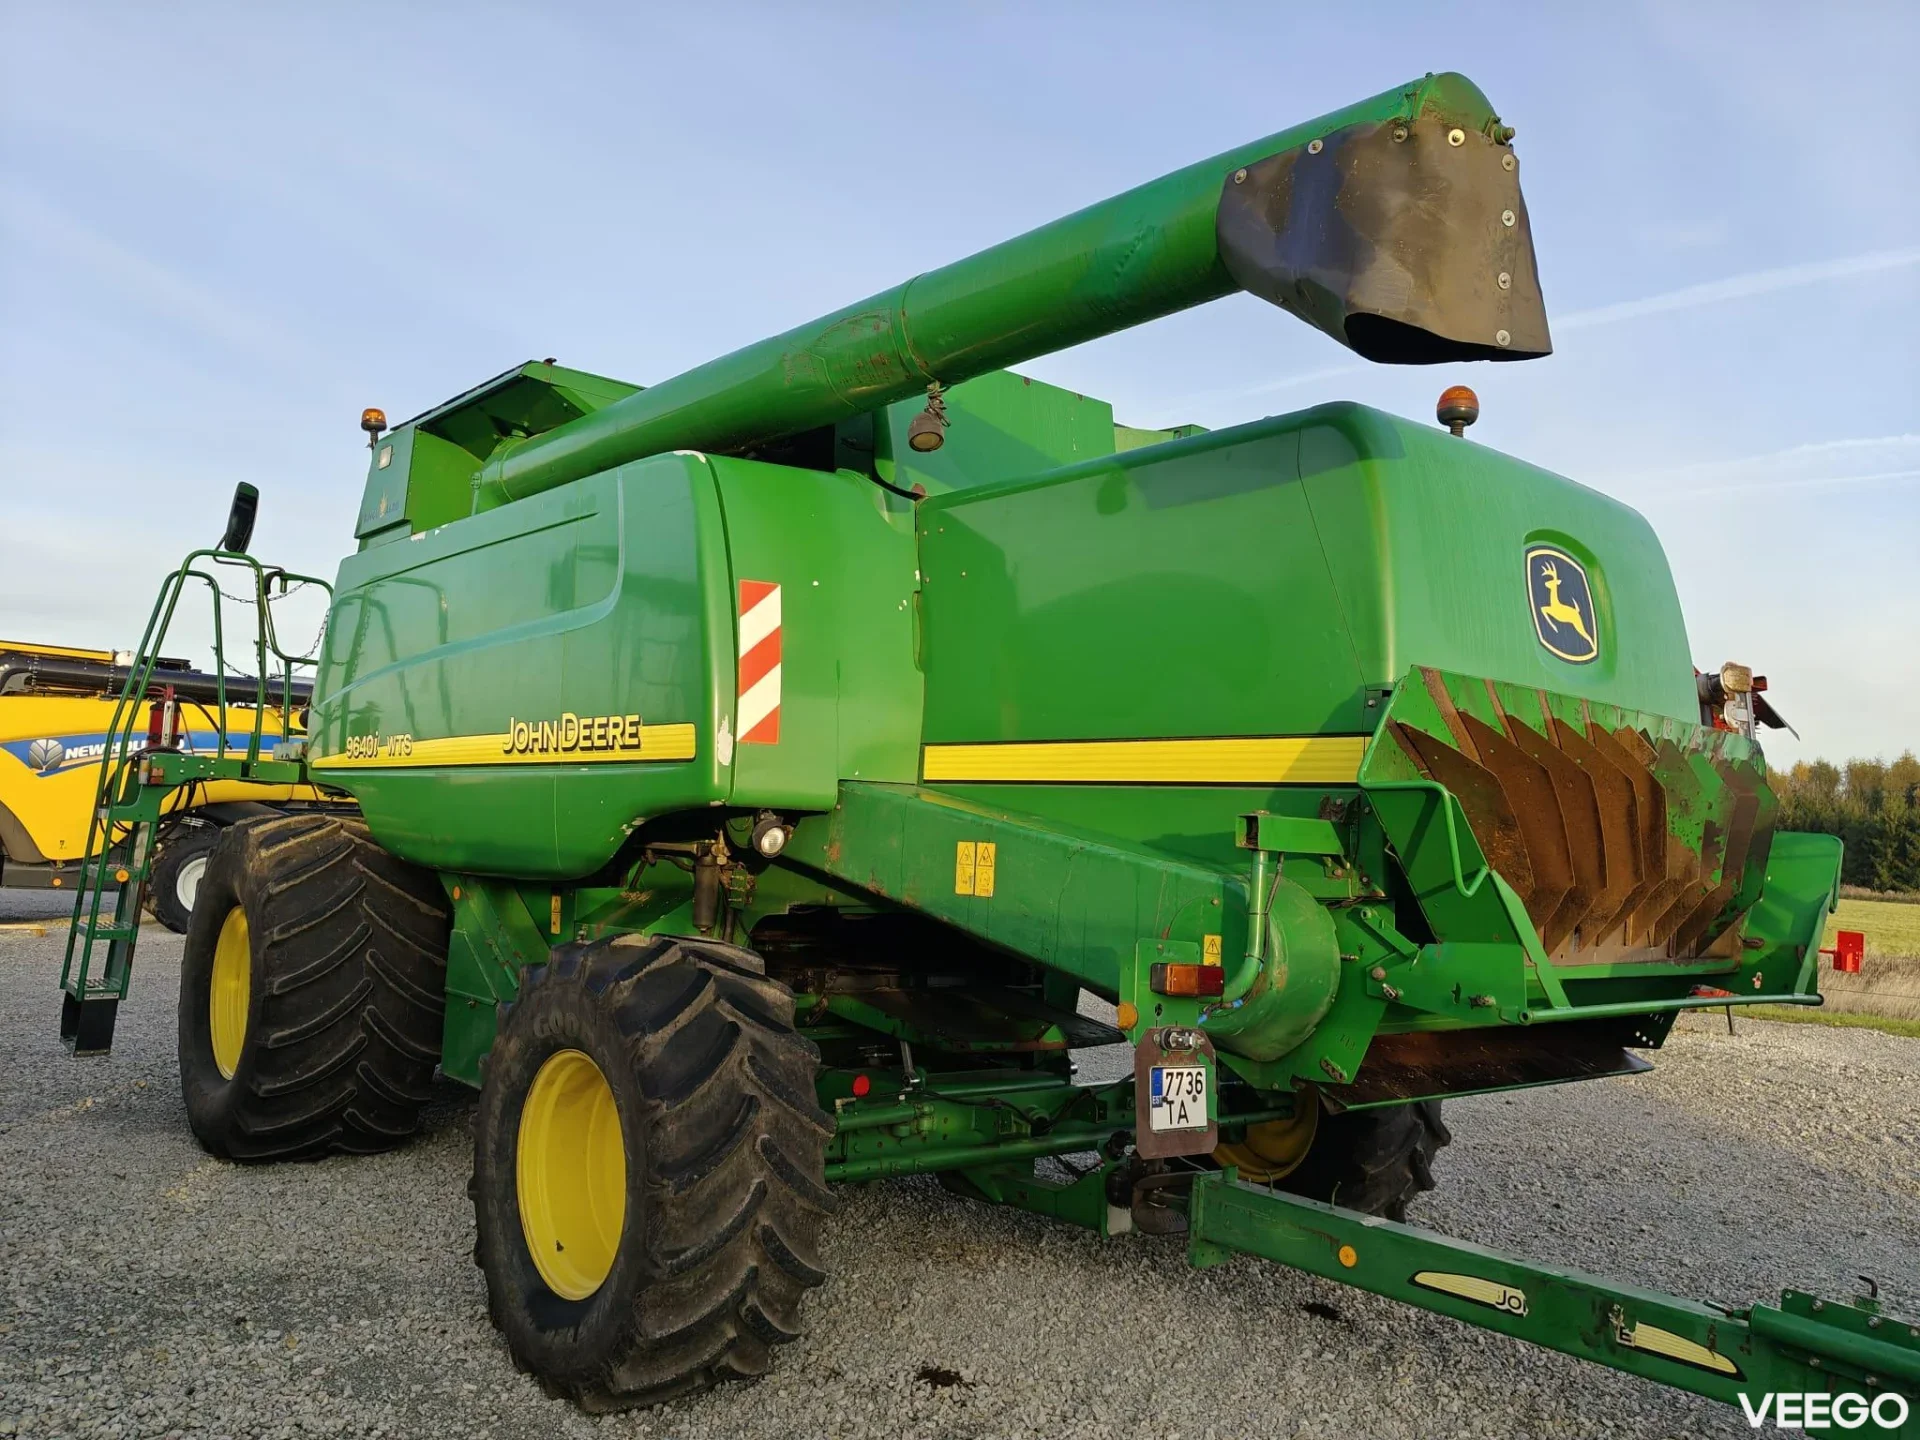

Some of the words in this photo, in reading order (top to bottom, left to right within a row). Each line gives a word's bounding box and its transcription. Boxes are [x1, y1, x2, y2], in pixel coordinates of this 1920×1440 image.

[346, 730, 379, 759] 9640i
[386, 733, 412, 757] WTS
[503, 716, 558, 754] JOHN
[561, 712, 642, 752] DEERE
[65, 743, 106, 760] NEW
[1165, 1071, 1203, 1096] 7736
[1166, 1099, 1189, 1125] TA
